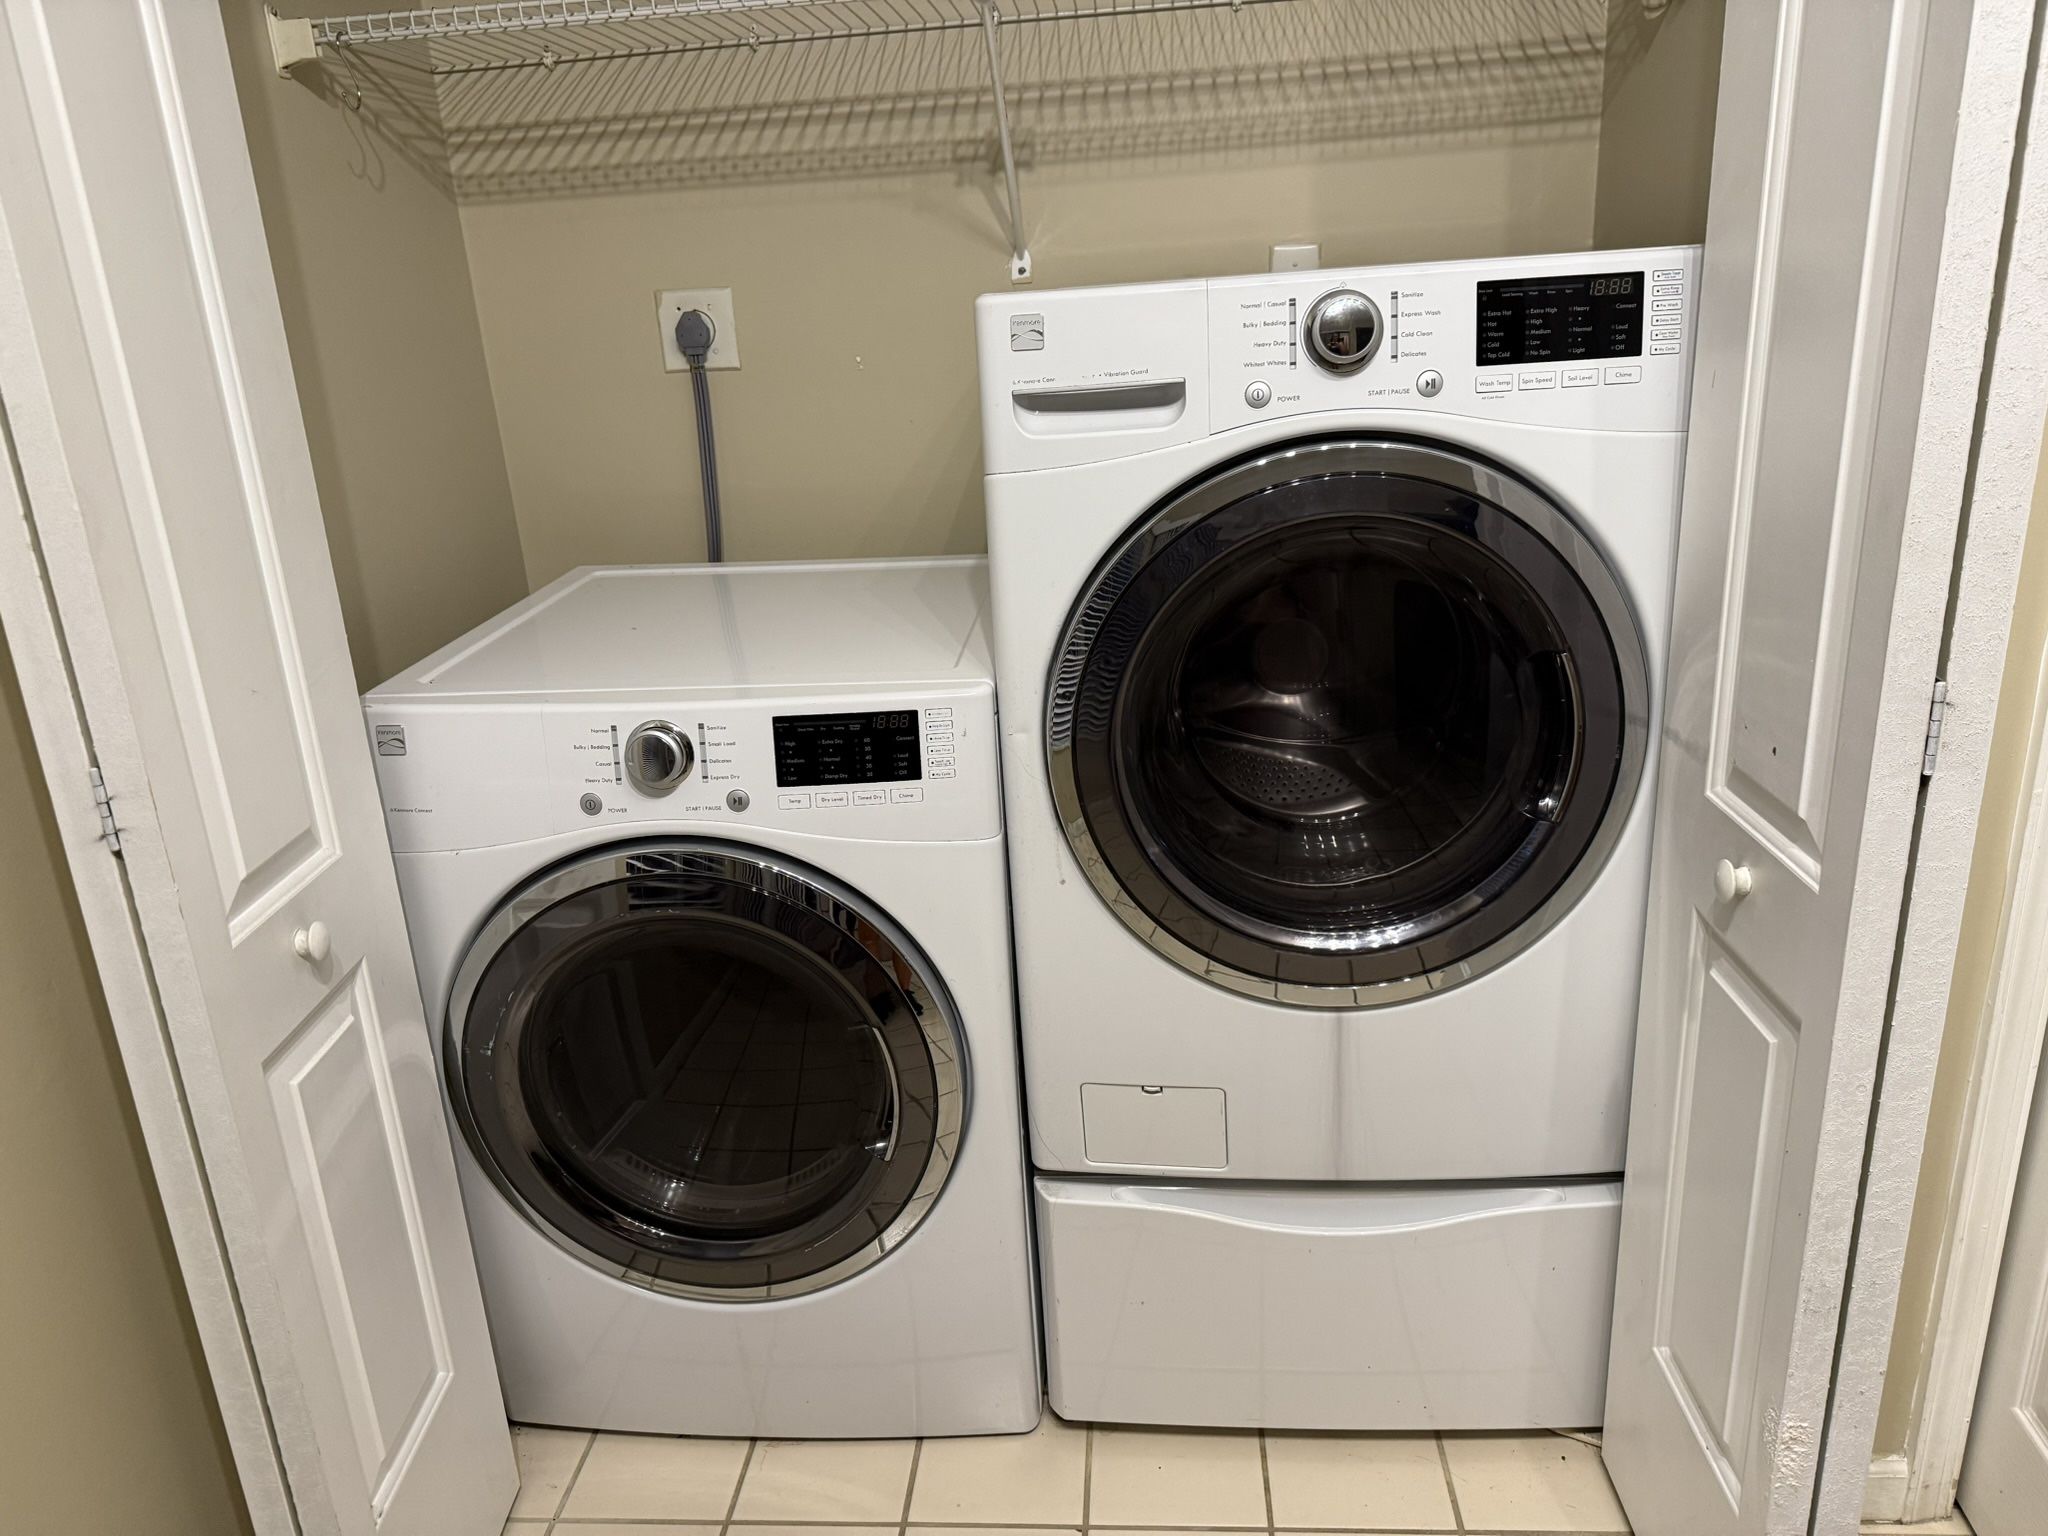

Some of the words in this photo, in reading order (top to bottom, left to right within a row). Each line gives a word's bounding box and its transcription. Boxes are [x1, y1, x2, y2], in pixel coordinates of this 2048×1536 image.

[1573, 305, 1590, 313] Heavy
[1401, 311, 1423, 319] Express
[1243, 321, 1259, 330] Bulky
[1263, 320, 1287, 328] Bedding
[1530, 318, 1543, 326] High
[1253, 341, 1272, 349] Heavy
[1273, 340, 1287, 348] Duty
[1130, 368, 1149, 376] Guard
[1496, 379, 1511, 388] Temp
[1521, 377, 1534, 385] Spin
[1535, 376, 1553, 384] Speed
[1277, 395, 1301, 403] POWER
